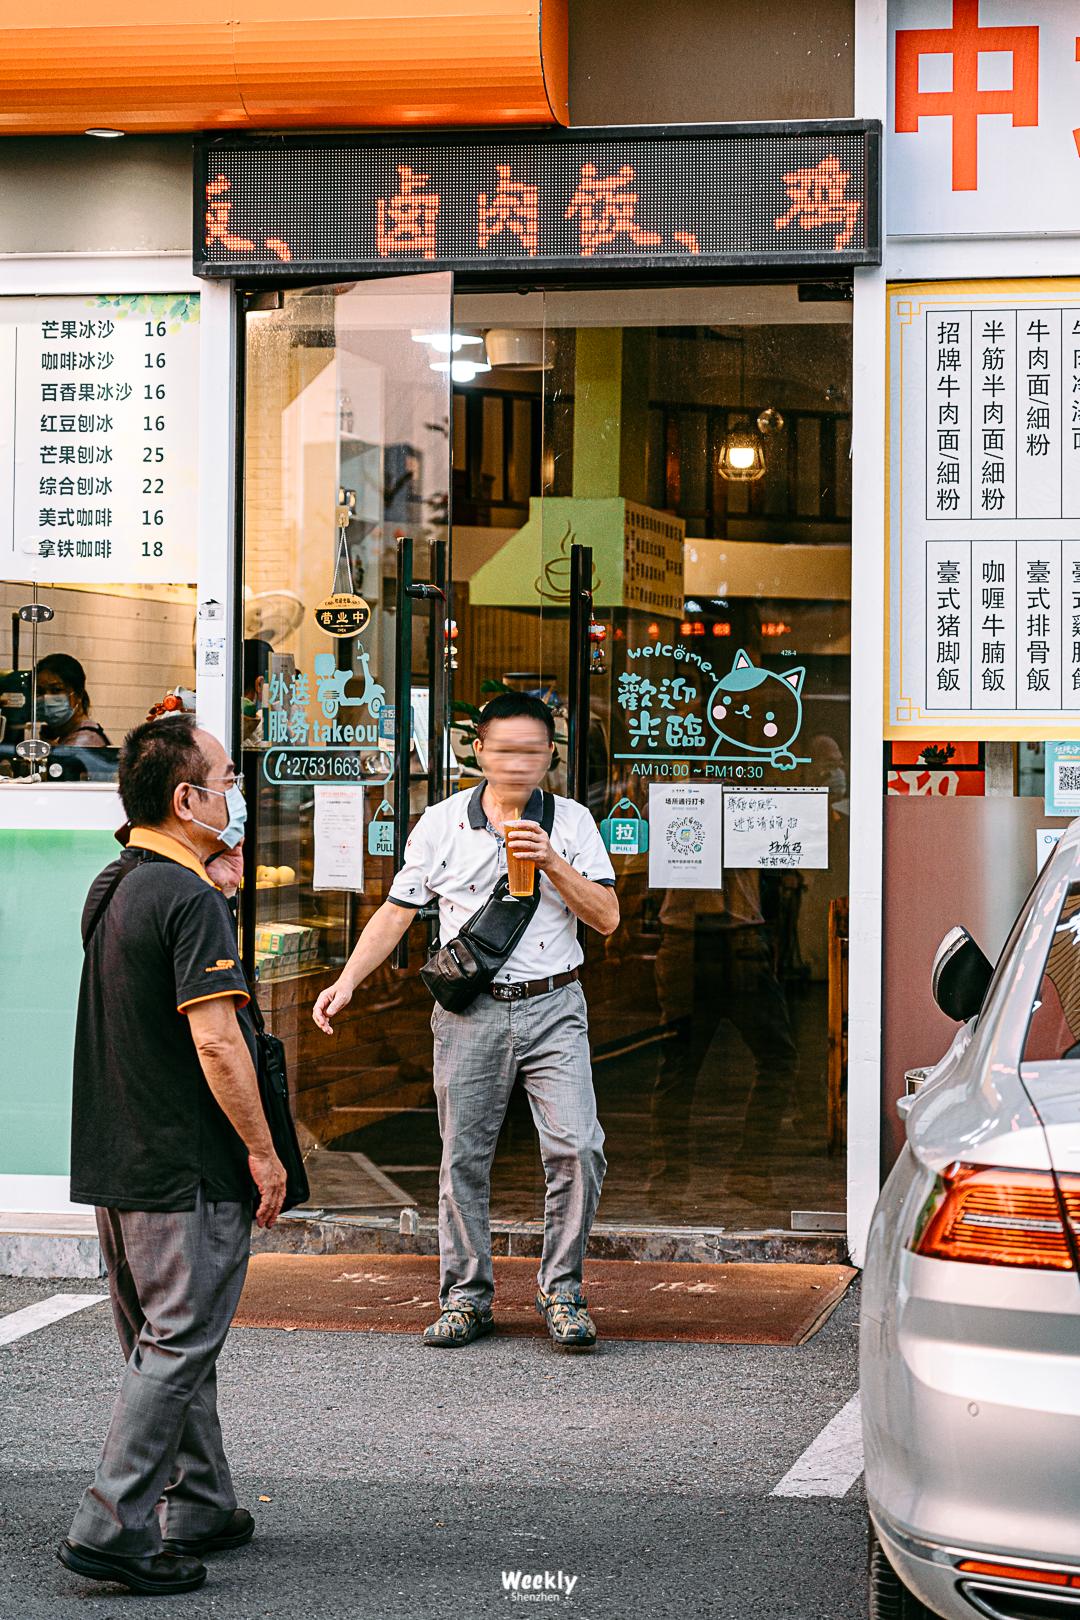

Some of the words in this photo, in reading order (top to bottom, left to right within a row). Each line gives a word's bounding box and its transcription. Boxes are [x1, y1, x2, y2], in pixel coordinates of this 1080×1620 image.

[895, 0, 1080, 191] 中
[42, 320, 114, 339] 芒果冰沙
[146, 322, 166, 336] 16
[42, 352, 114, 370] 咖啡冰沙
[145, 353, 165, 368] 16
[41, 383, 132, 401] 百香果冰沙
[145, 384, 165, 399] 16
[41, 414, 113, 432] 红豆刨冰
[144, 416, 164, 431] 16
[40, 446, 112, 464] 芒果刨冰
[143, 448, 163, 462] 25
[40, 477, 112, 495] 综合刨冰
[143, 479, 163, 493] 22
[39, 508, 112, 526] 美式咖啡
[143, 510, 163, 525] 16
[38, 540, 111, 558] 拿铁咖啡
[142, 542, 162, 556] 18
[320, 610, 364, 625] 营业中
[269, 672, 310, 706] 外送
[269, 710, 310, 743] 服务
[312, 719, 378, 743] takeou
[630, 763, 689, 777] AM10:00
[616, 823, 635, 841] 拉
[376, 842, 394, 852] PULL
